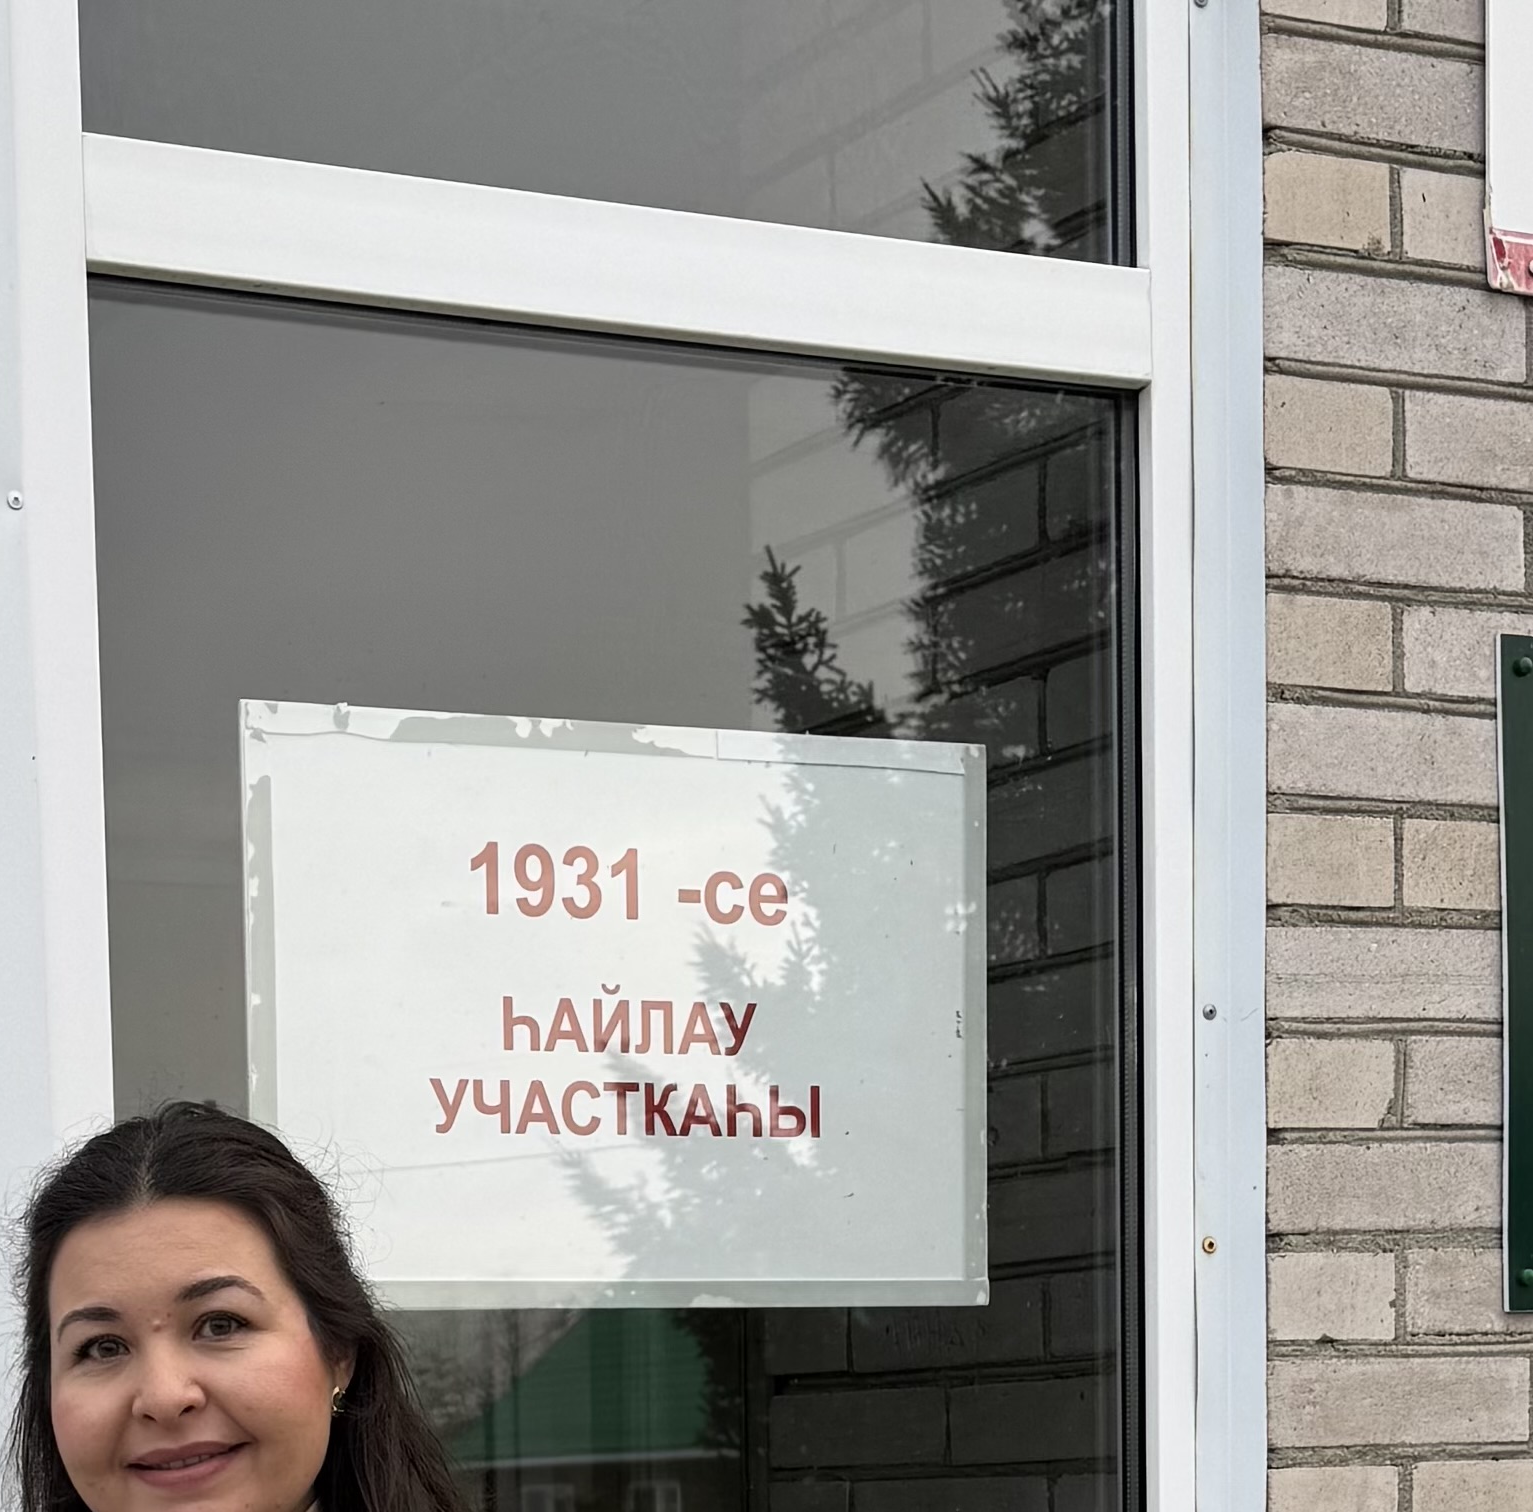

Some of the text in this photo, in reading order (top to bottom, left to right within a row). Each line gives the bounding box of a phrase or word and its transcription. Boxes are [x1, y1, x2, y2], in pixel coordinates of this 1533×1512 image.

[470, 840, 790, 927] 1931 -се
[501, 983, 758, 1057] ҺАЙЛАУ
[429, 1078, 822, 1139] УЧАСТКАҺЫ
